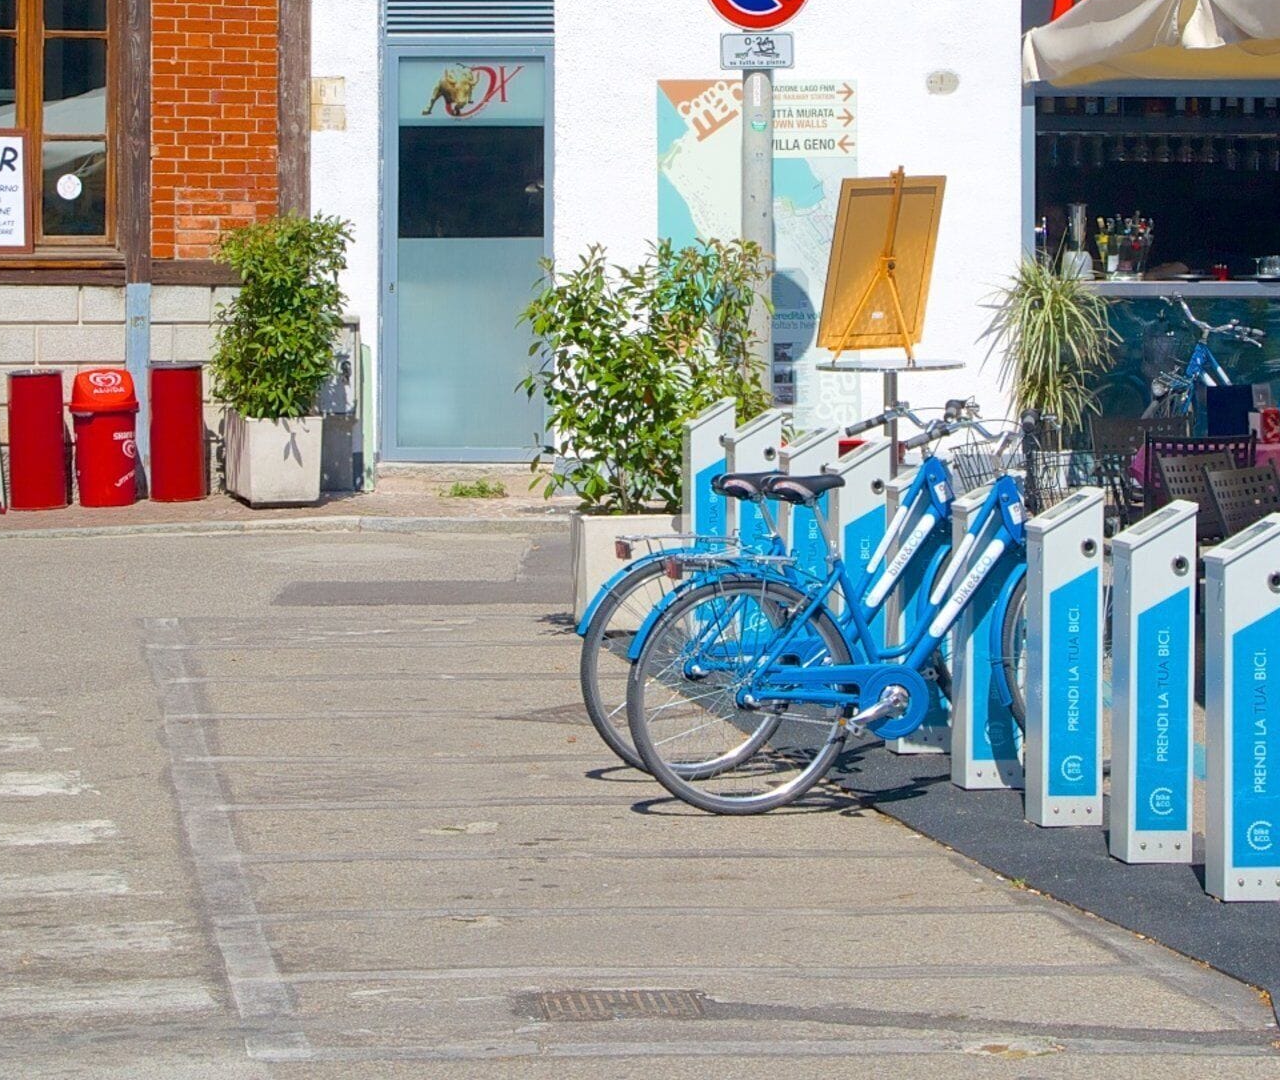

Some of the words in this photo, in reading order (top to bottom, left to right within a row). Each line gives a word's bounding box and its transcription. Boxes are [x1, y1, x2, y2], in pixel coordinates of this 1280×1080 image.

[772, 107, 794, 118] ITTÀ
[796, 108, 834, 118] MURATA
[796, 119, 828, 128] WALLS
[804, 138, 836, 151] GENO
[1067, 604, 1080, 633] BICI.
[1067, 636, 1080, 665] TUA
[1157, 625, 1170, 658] BICI.
[1067, 665, 1080, 681] LA
[1157, 660, 1170, 689] TUA
[1254, 647, 1267, 681] BICI.
[1067, 685, 1080, 732] PRENDI
[1157, 692, 1170, 709] LA
[1254, 684, 1267, 715] TUA
[1157, 712, 1170, 762] PRENDI
[1254, 718, 1267, 736] LA
[1254, 740, 1267, 793] PRENDI
